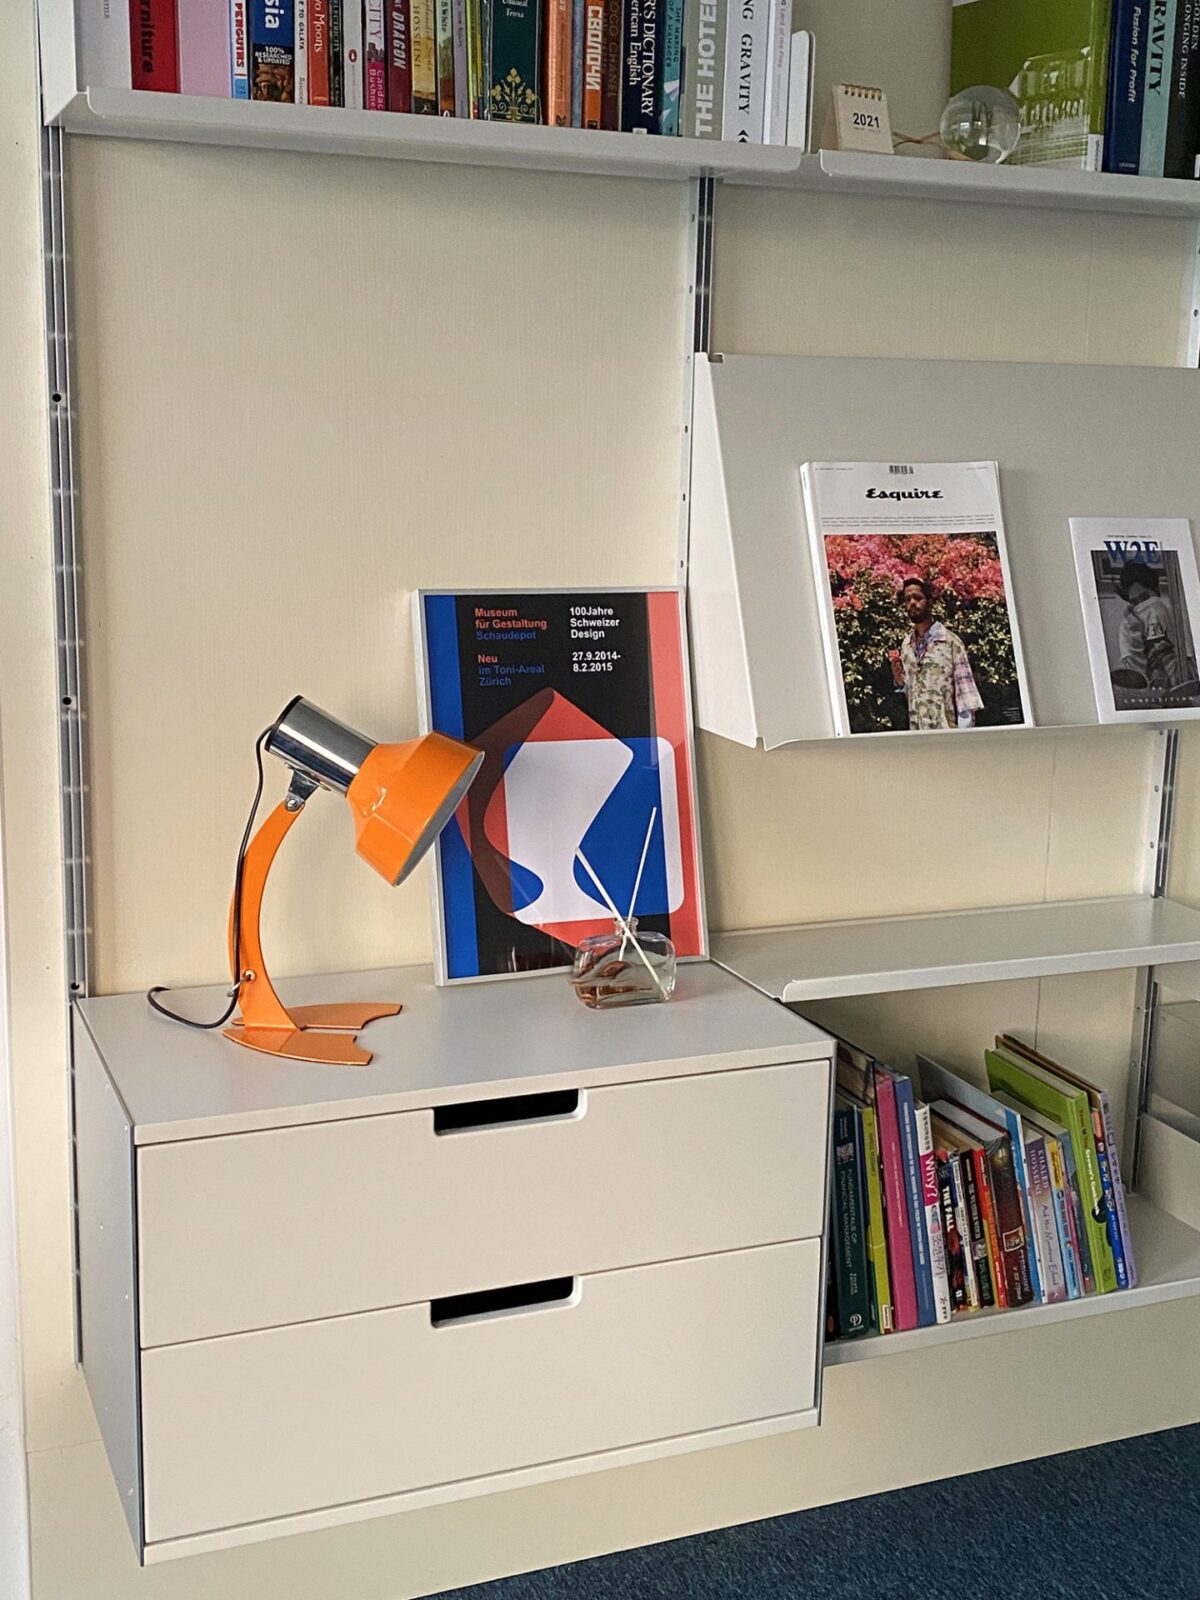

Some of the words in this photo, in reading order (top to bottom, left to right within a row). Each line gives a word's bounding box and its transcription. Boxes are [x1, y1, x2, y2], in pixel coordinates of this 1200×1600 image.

[298, 9, 305, 18] TO
[1130, 6, 1142, 45] Fusion
[1181, 0, 1192, 54] ONGING
[234, 3, 245, 67] PENGUINS
[313, 13, 326, 52] Moons
[392, 11, 406, 69] DRAGON
[412, 6, 422, 68] HOSSEINI
[586, 5, 602, 90] СВОЛОЧИ
[627, 42, 642, 85] English
[641, 23, 655, 117] DICTIONARY
[1129, 48, 1140, 66] for
[739, 34, 753, 115] GRAVITY
[1127, 69, 1137, 104] Profit
[1177, 58, 1188, 99] INSIDE
[376, 70, 384, 110] Candac
[695, 84, 714, 136] THE
[852, 112, 880, 129] 2021
[865, 488, 944, 501] Esquire
[474, 608, 518, 617] Museum
[475, 619, 489, 629] für
[492, 619, 548, 631] Gestaltung
[569, 606, 614, 616] 100Jahre
[570, 617, 620, 628] Schweizer
[476, 630, 537, 641] Schaudepot
[570, 629, 605, 640] Design
[477, 654, 498, 663] Neu
[478, 665, 491, 675] im
[494, 664, 545, 674] Toni-Areal
[572, 651, 621, 661] 27.9.2014-
[572, 662, 613, 673] 8.2.2015
[479, 676, 512, 686] Zürich
[925, 1155, 938, 1198] Why?
[1030, 1150, 1042, 1195] HOSSEINI
[1038, 1149, 1049, 1189] KHALED
[942, 1186, 952, 1206] THE
[944, 1207, 955, 1232] FALL
